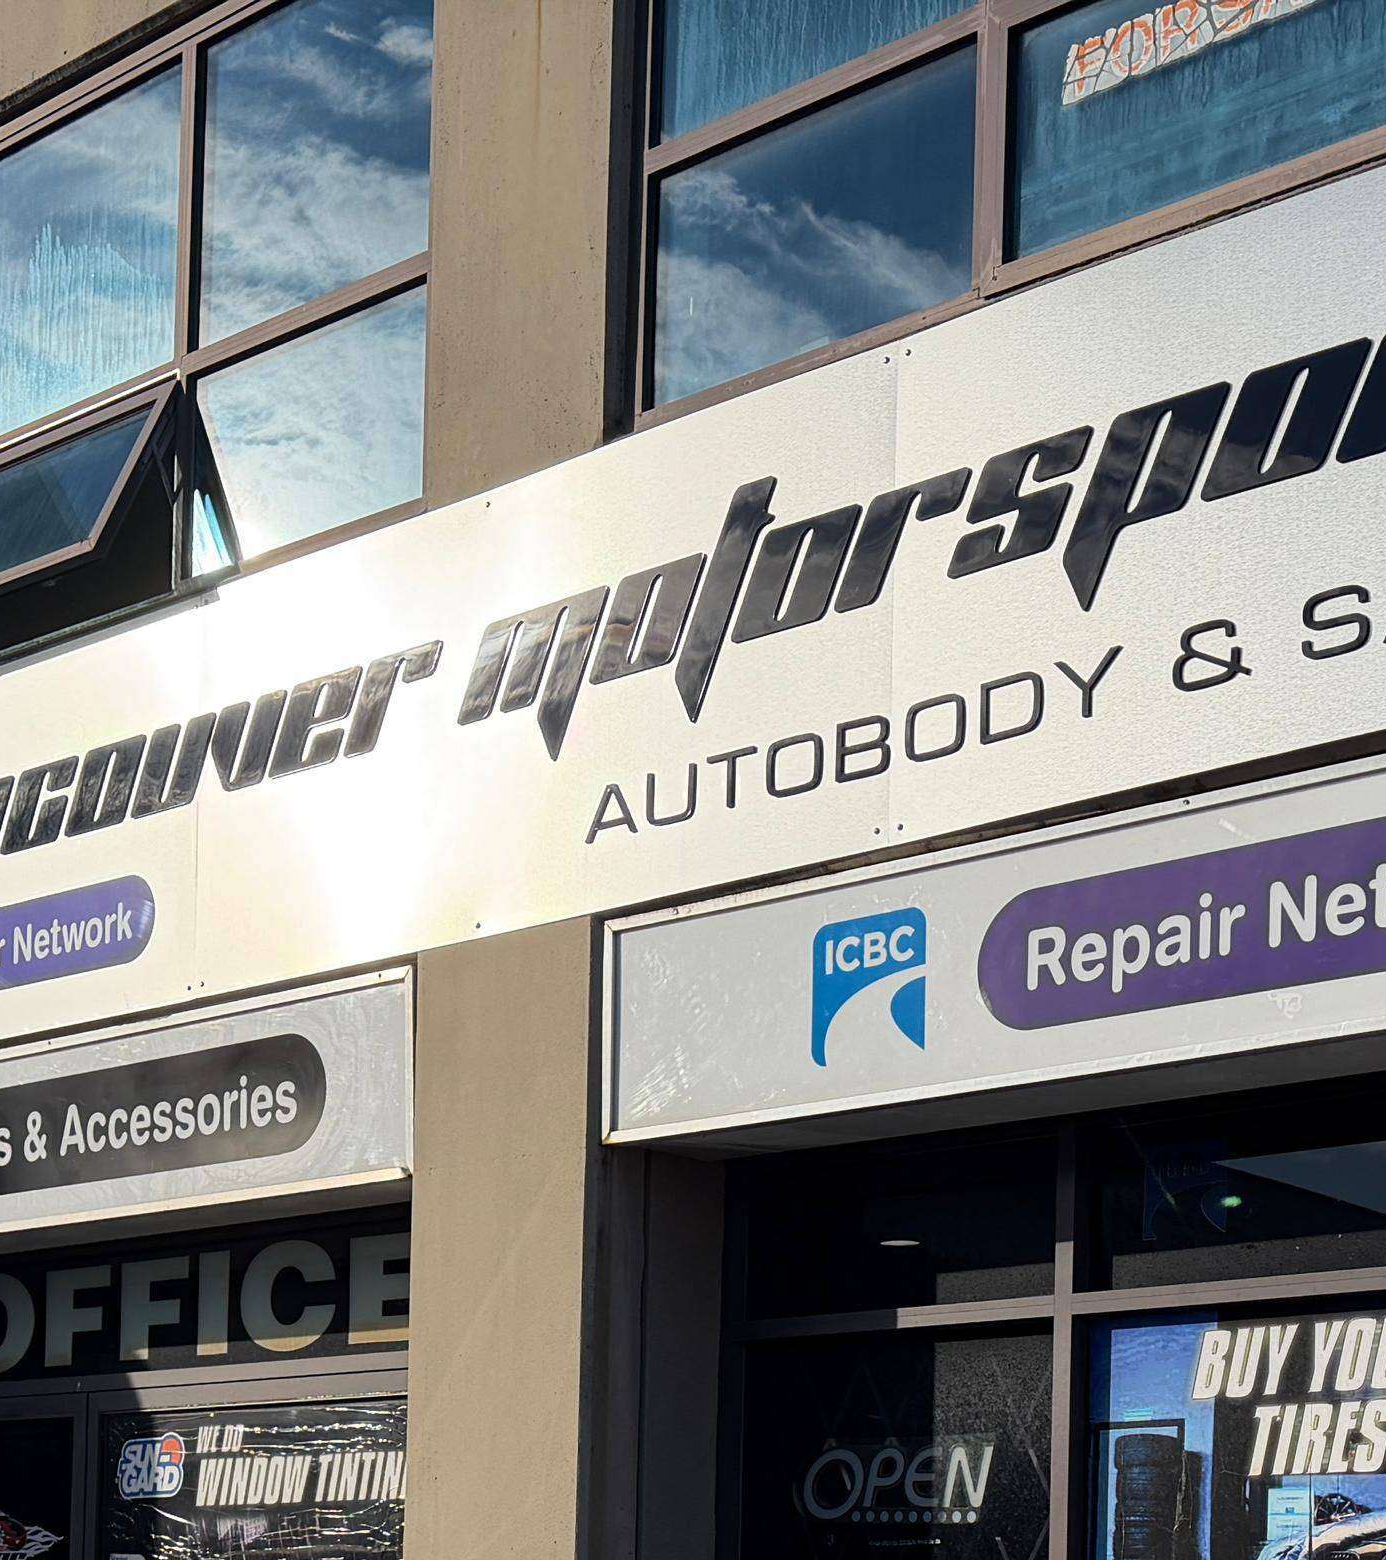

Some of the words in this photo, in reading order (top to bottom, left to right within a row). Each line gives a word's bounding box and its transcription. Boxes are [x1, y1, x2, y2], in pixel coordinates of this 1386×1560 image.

[583, 642, 1122, 844] AUTOBODY
[1173, 618, 1250, 691] &
[13, 902, 133, 966] Network
[822, 923, 918, 977] ICBC
[1024, 901, 1247, 992] Repair
[23, 1112, 47, 1161] &
[59, 1075, 299, 1157] Accessories
[1191, 1323, 1298, 1400] BUY
[122, 1464, 180, 1493] GARD
[196, 1455, 312, 1506] WINDOW
[315, 1452, 407, 1502] TINTIN
[803, 1442, 994, 1519] OPEN
